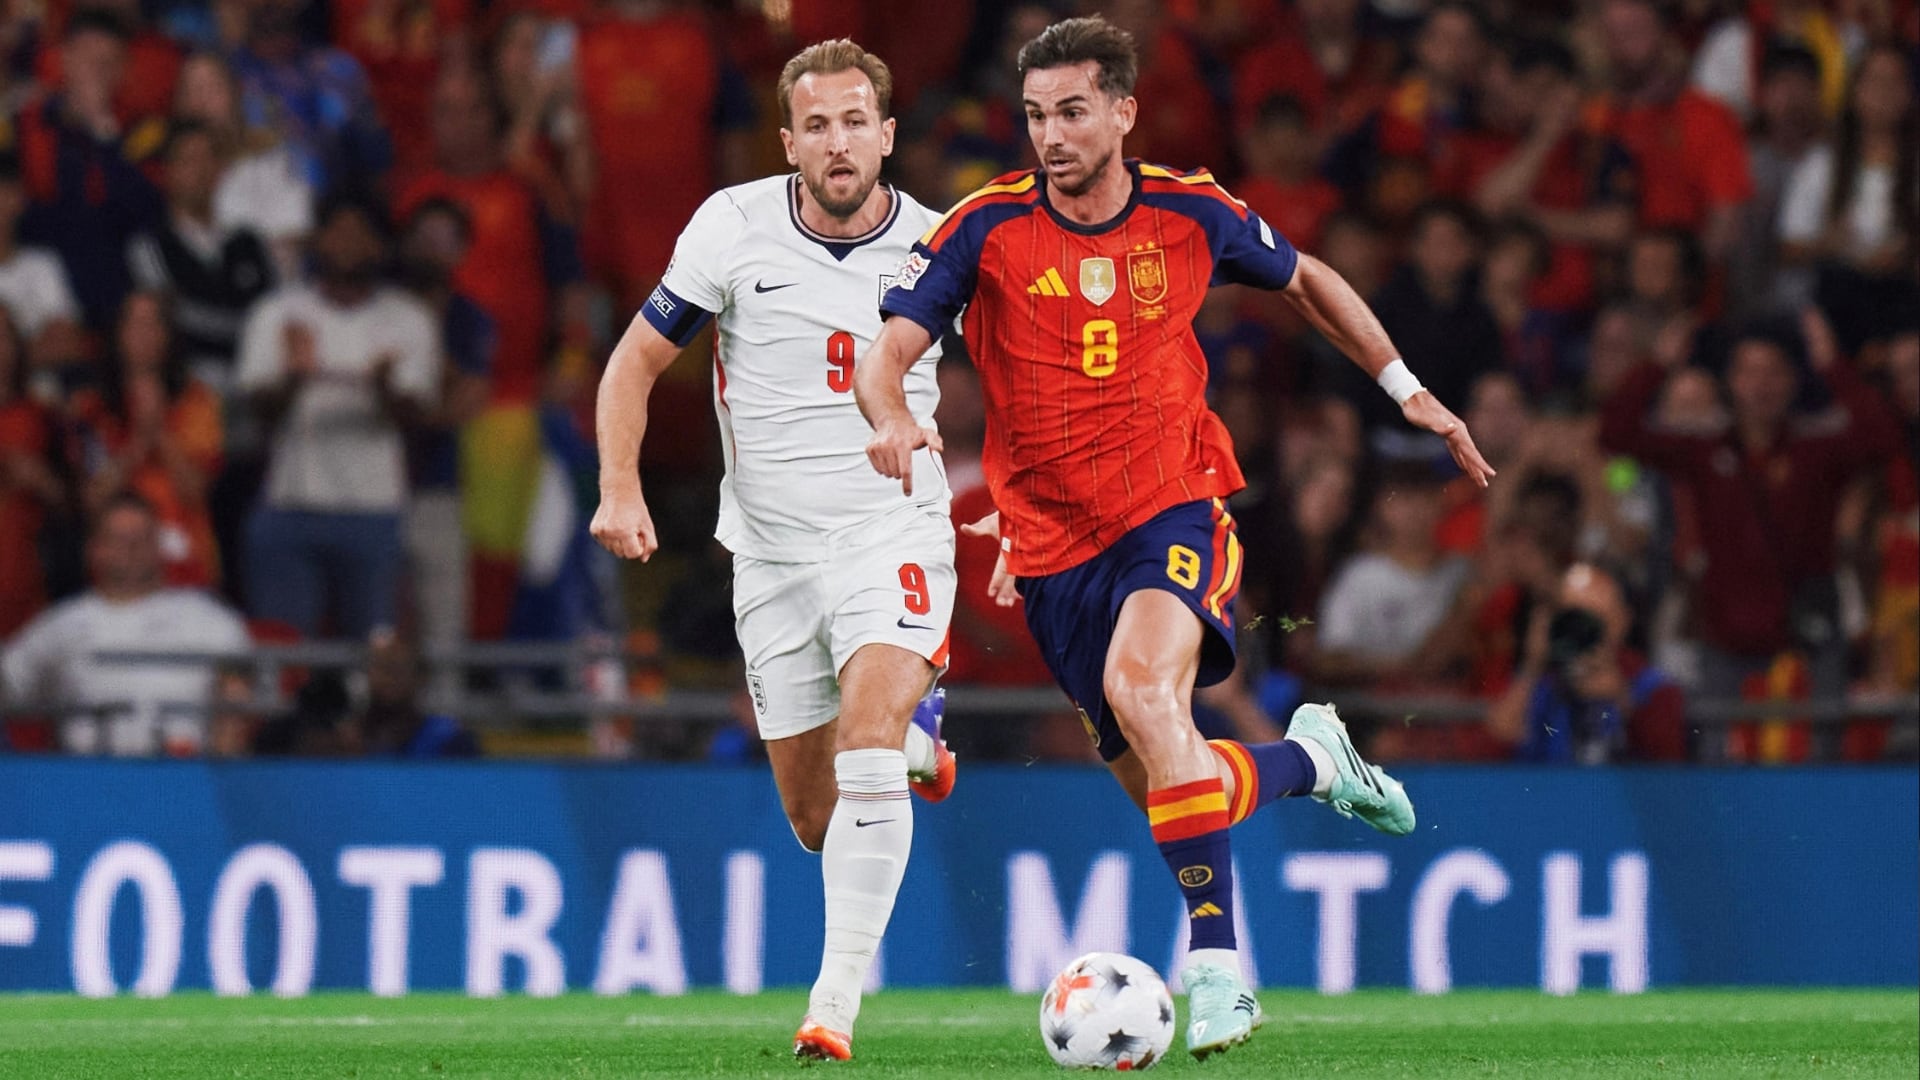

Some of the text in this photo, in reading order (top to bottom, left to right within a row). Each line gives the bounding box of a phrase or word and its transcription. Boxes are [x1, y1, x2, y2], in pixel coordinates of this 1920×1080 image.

[827, 331, 855, 393] 9
[1082, 319, 1118, 377] 8
[898, 563, 931, 616] 9
[1166, 544, 1200, 590] 8
[0, 839, 884, 997] FOOTBAL
